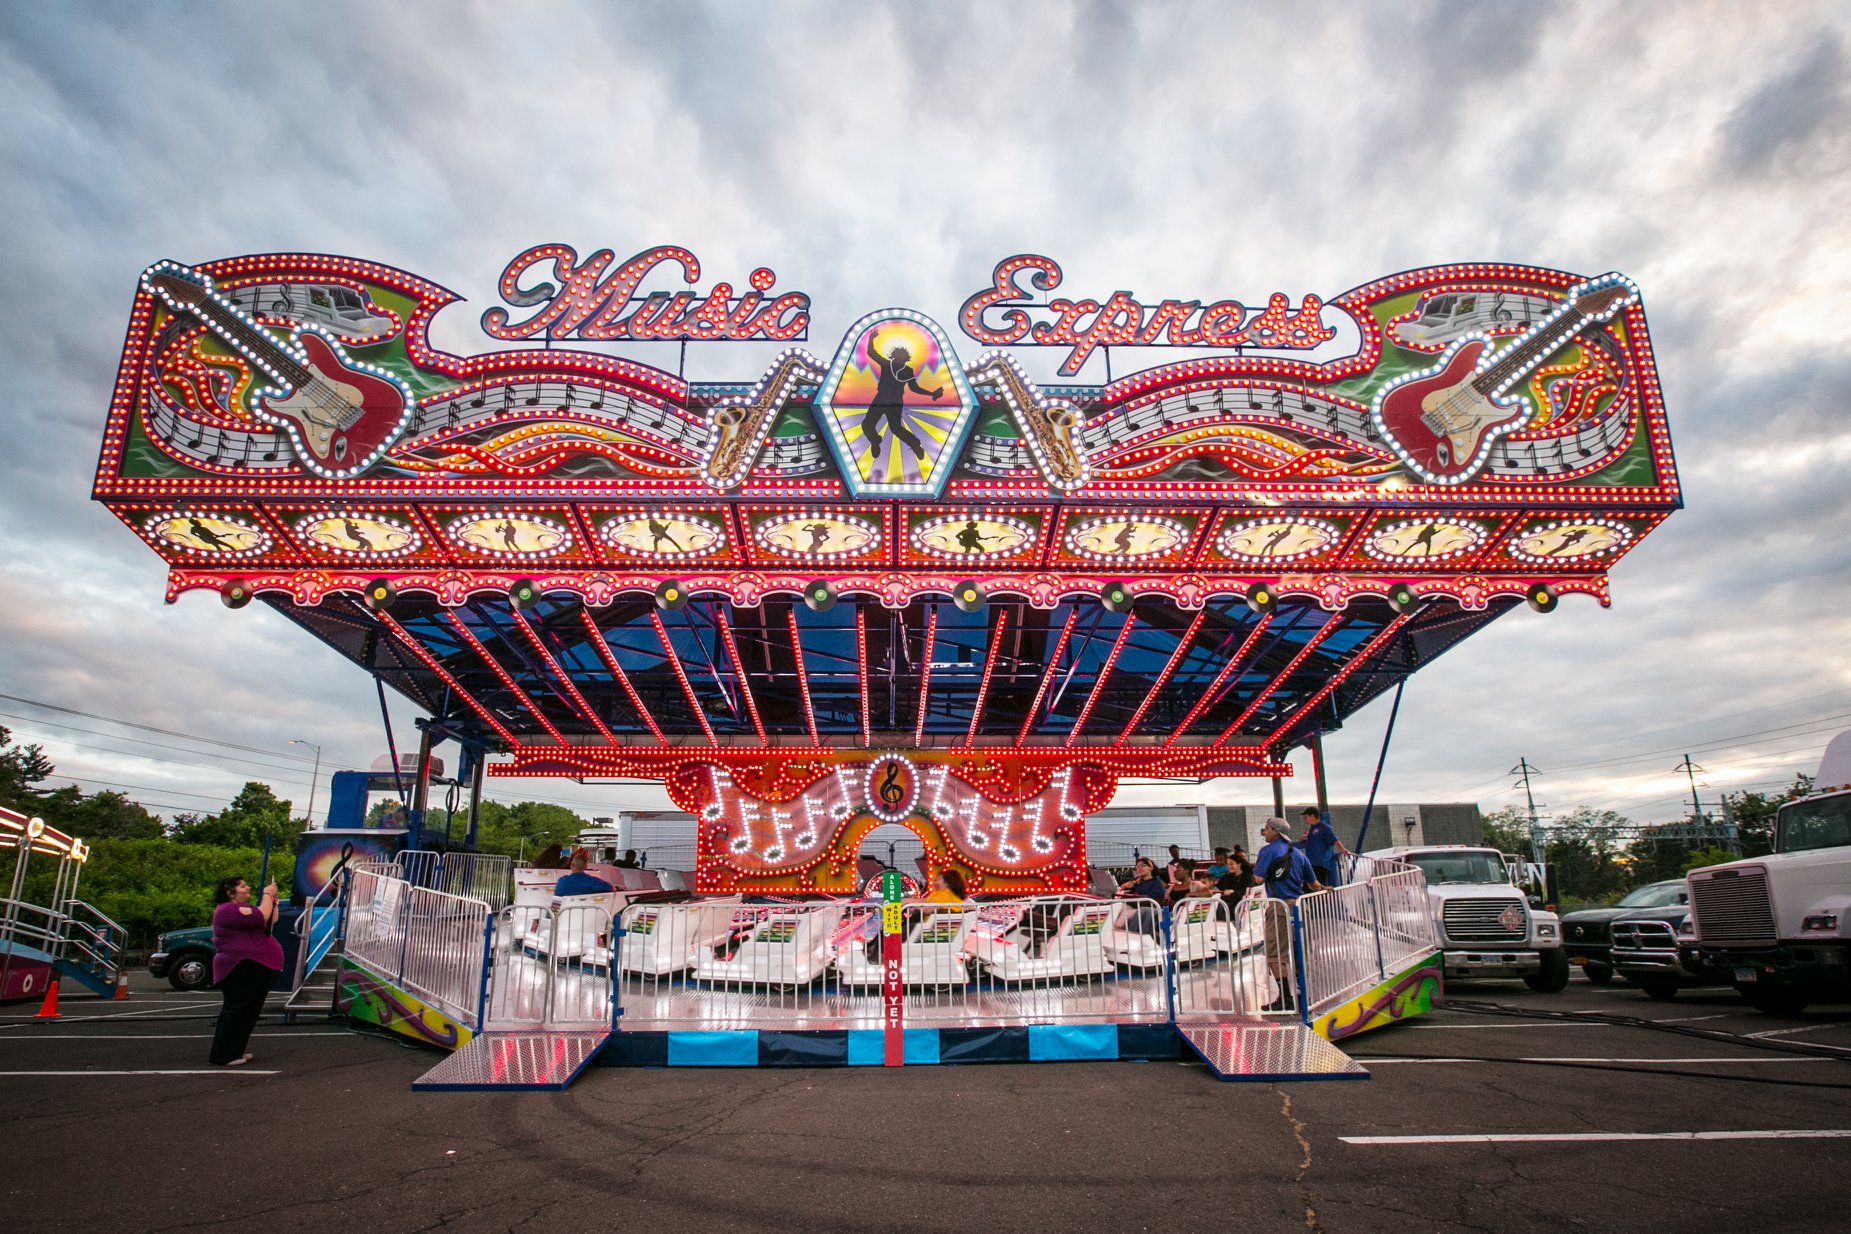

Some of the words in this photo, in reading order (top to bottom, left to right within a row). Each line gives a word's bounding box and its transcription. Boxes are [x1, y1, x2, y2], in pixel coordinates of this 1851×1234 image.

[480, 243, 811, 340] Music
[958, 253, 1338, 377] Express
[888, 959, 898, 991] NOT
[889, 996, 899, 1029] YET
